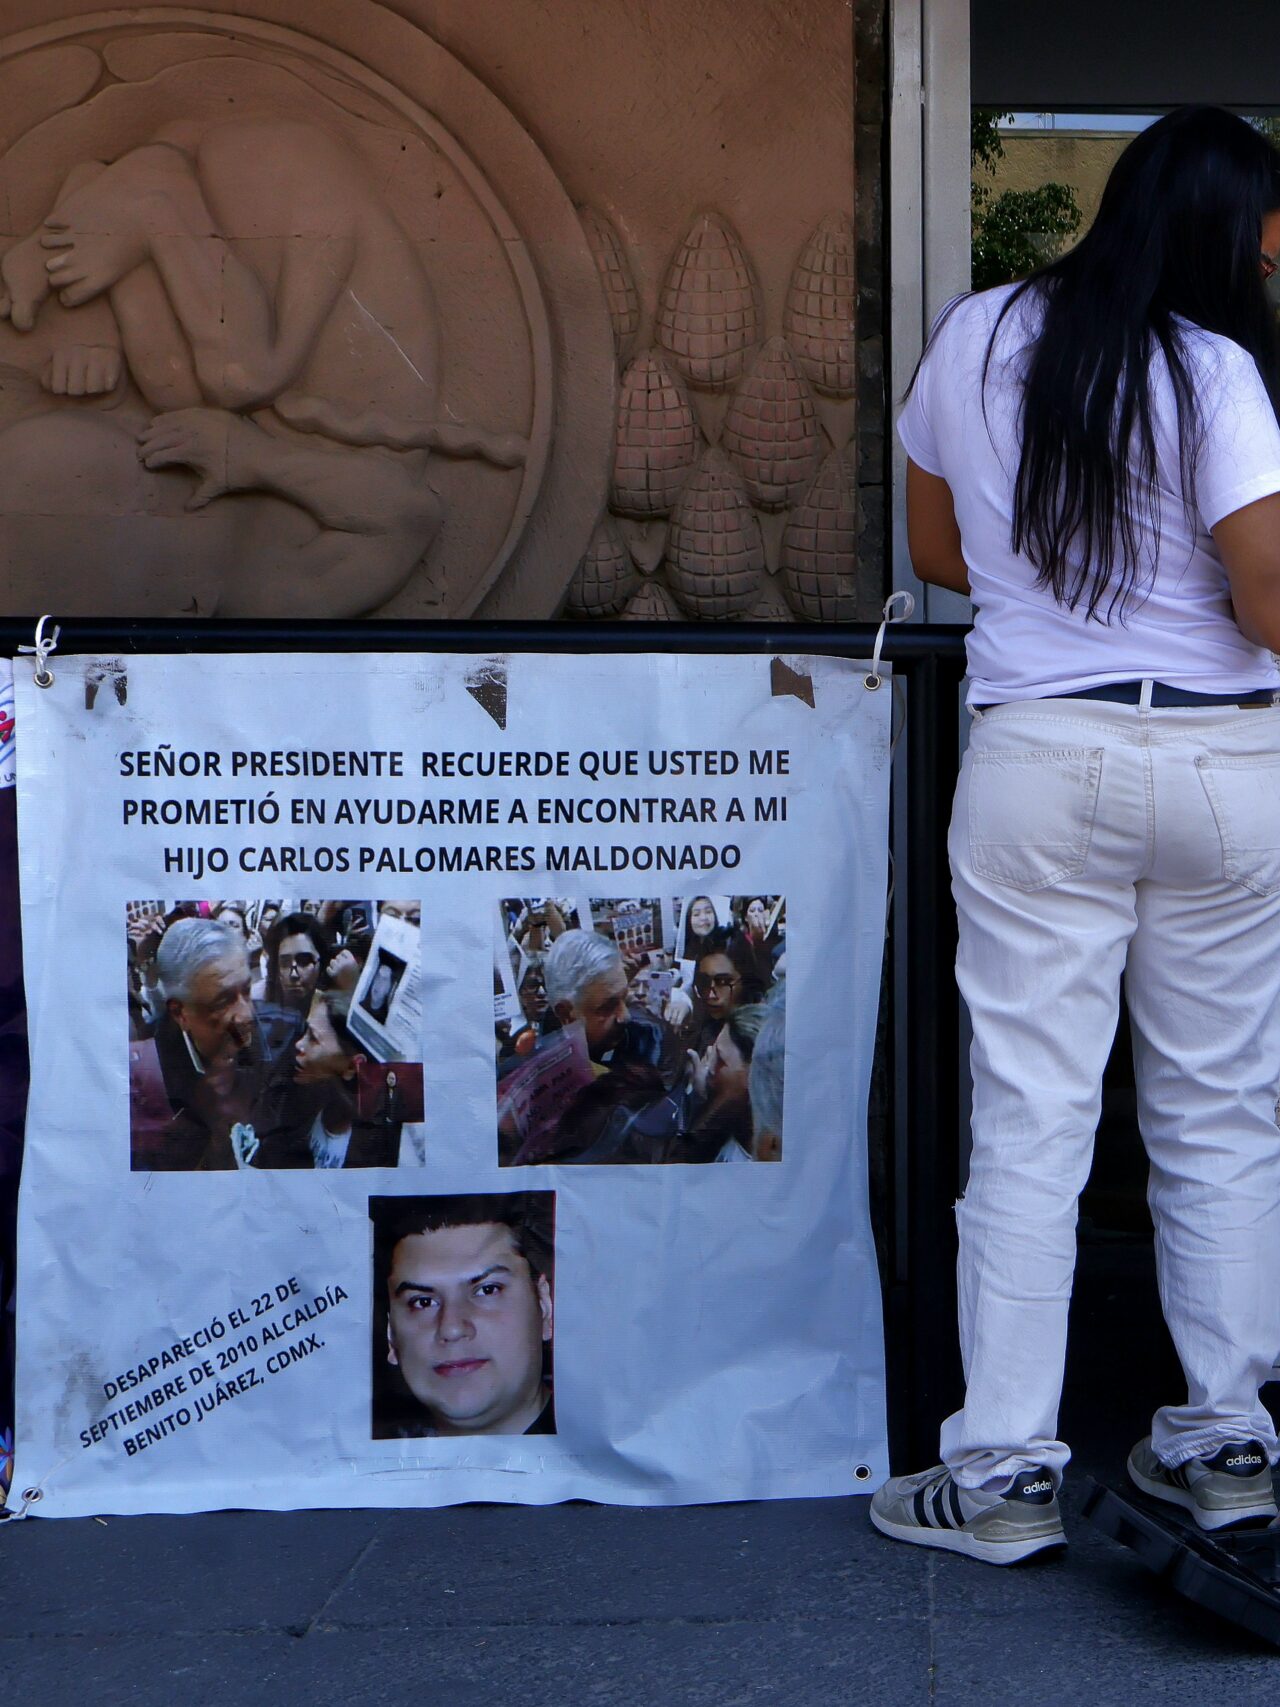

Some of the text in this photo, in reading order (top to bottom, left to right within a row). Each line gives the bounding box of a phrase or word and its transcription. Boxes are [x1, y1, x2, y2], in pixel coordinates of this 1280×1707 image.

[120, 743, 790, 781] SEÑOR PRESIDENTE RECUERDE QUE USTED ME
[123, 791, 788, 825] PROMETIÓ EN AYUDARME A ENCONTRAR A MI
[164, 845, 742, 880] HIJO CARLOS PALOMARES MALDONADO
[103, 1277, 301, 1401] DESAPARECIÓ EL 22 DE
[79, 1285, 349, 1448] SEPTIEMBRE DE 2010 ALCALDÍA
[123, 1332, 326, 1457] BENITO JUÁREZ, CDMX.
[1226, 1454, 1262, 1467] adidas
[1023, 1479, 1052, 1495] adidas
